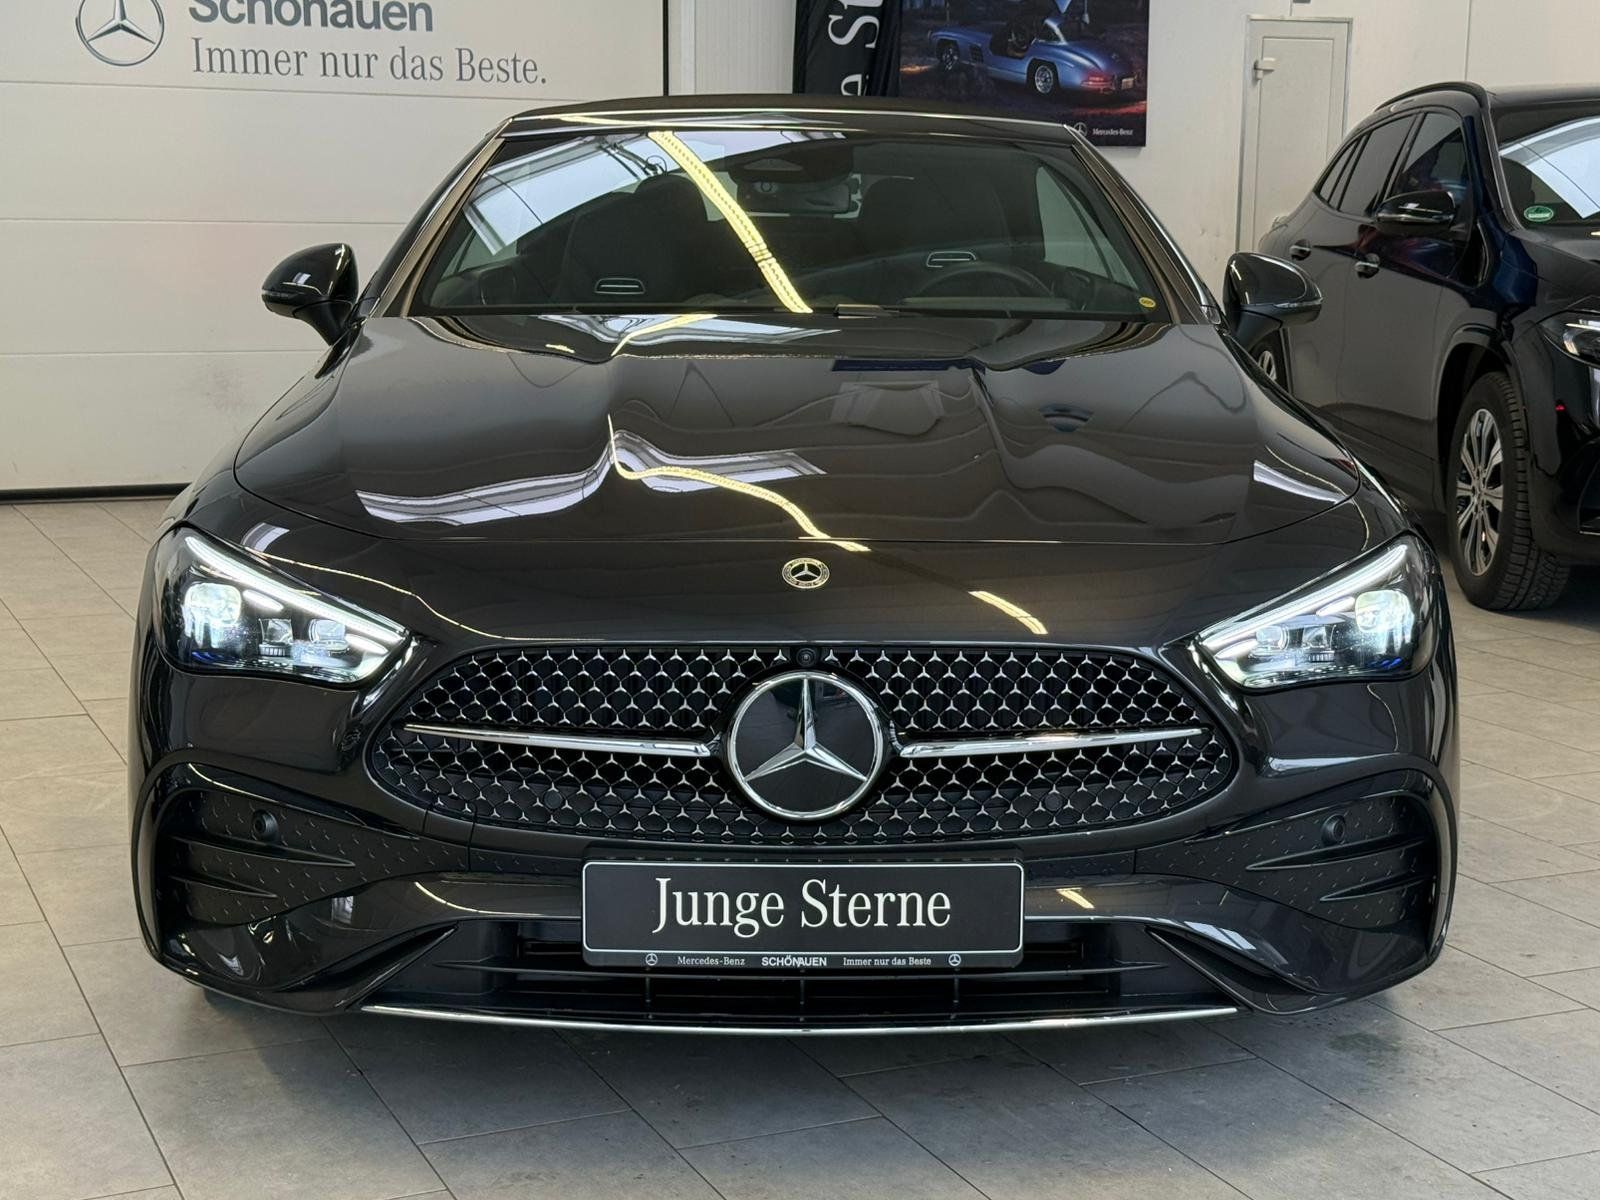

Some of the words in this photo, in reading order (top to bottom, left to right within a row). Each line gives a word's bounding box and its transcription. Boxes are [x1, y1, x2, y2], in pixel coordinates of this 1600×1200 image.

[191, 37, 308, 77] Immer
[320, 51, 378, 79] nur
[390, 46, 444, 81] das
[455, 47, 546, 84] Beste.
[651, 877, 784, 938] Junge
[801, 879, 951, 928] Sterne
[677, 956, 746, 966] Mercedes-Benz
[761, 954, 827, 967] SCHÖNAUEN
[843, 957, 872, 966] Immer
[874, 958, 889, 966] nur
[891, 957, 906, 966] das
[908, 957, 932, 966] Beste
